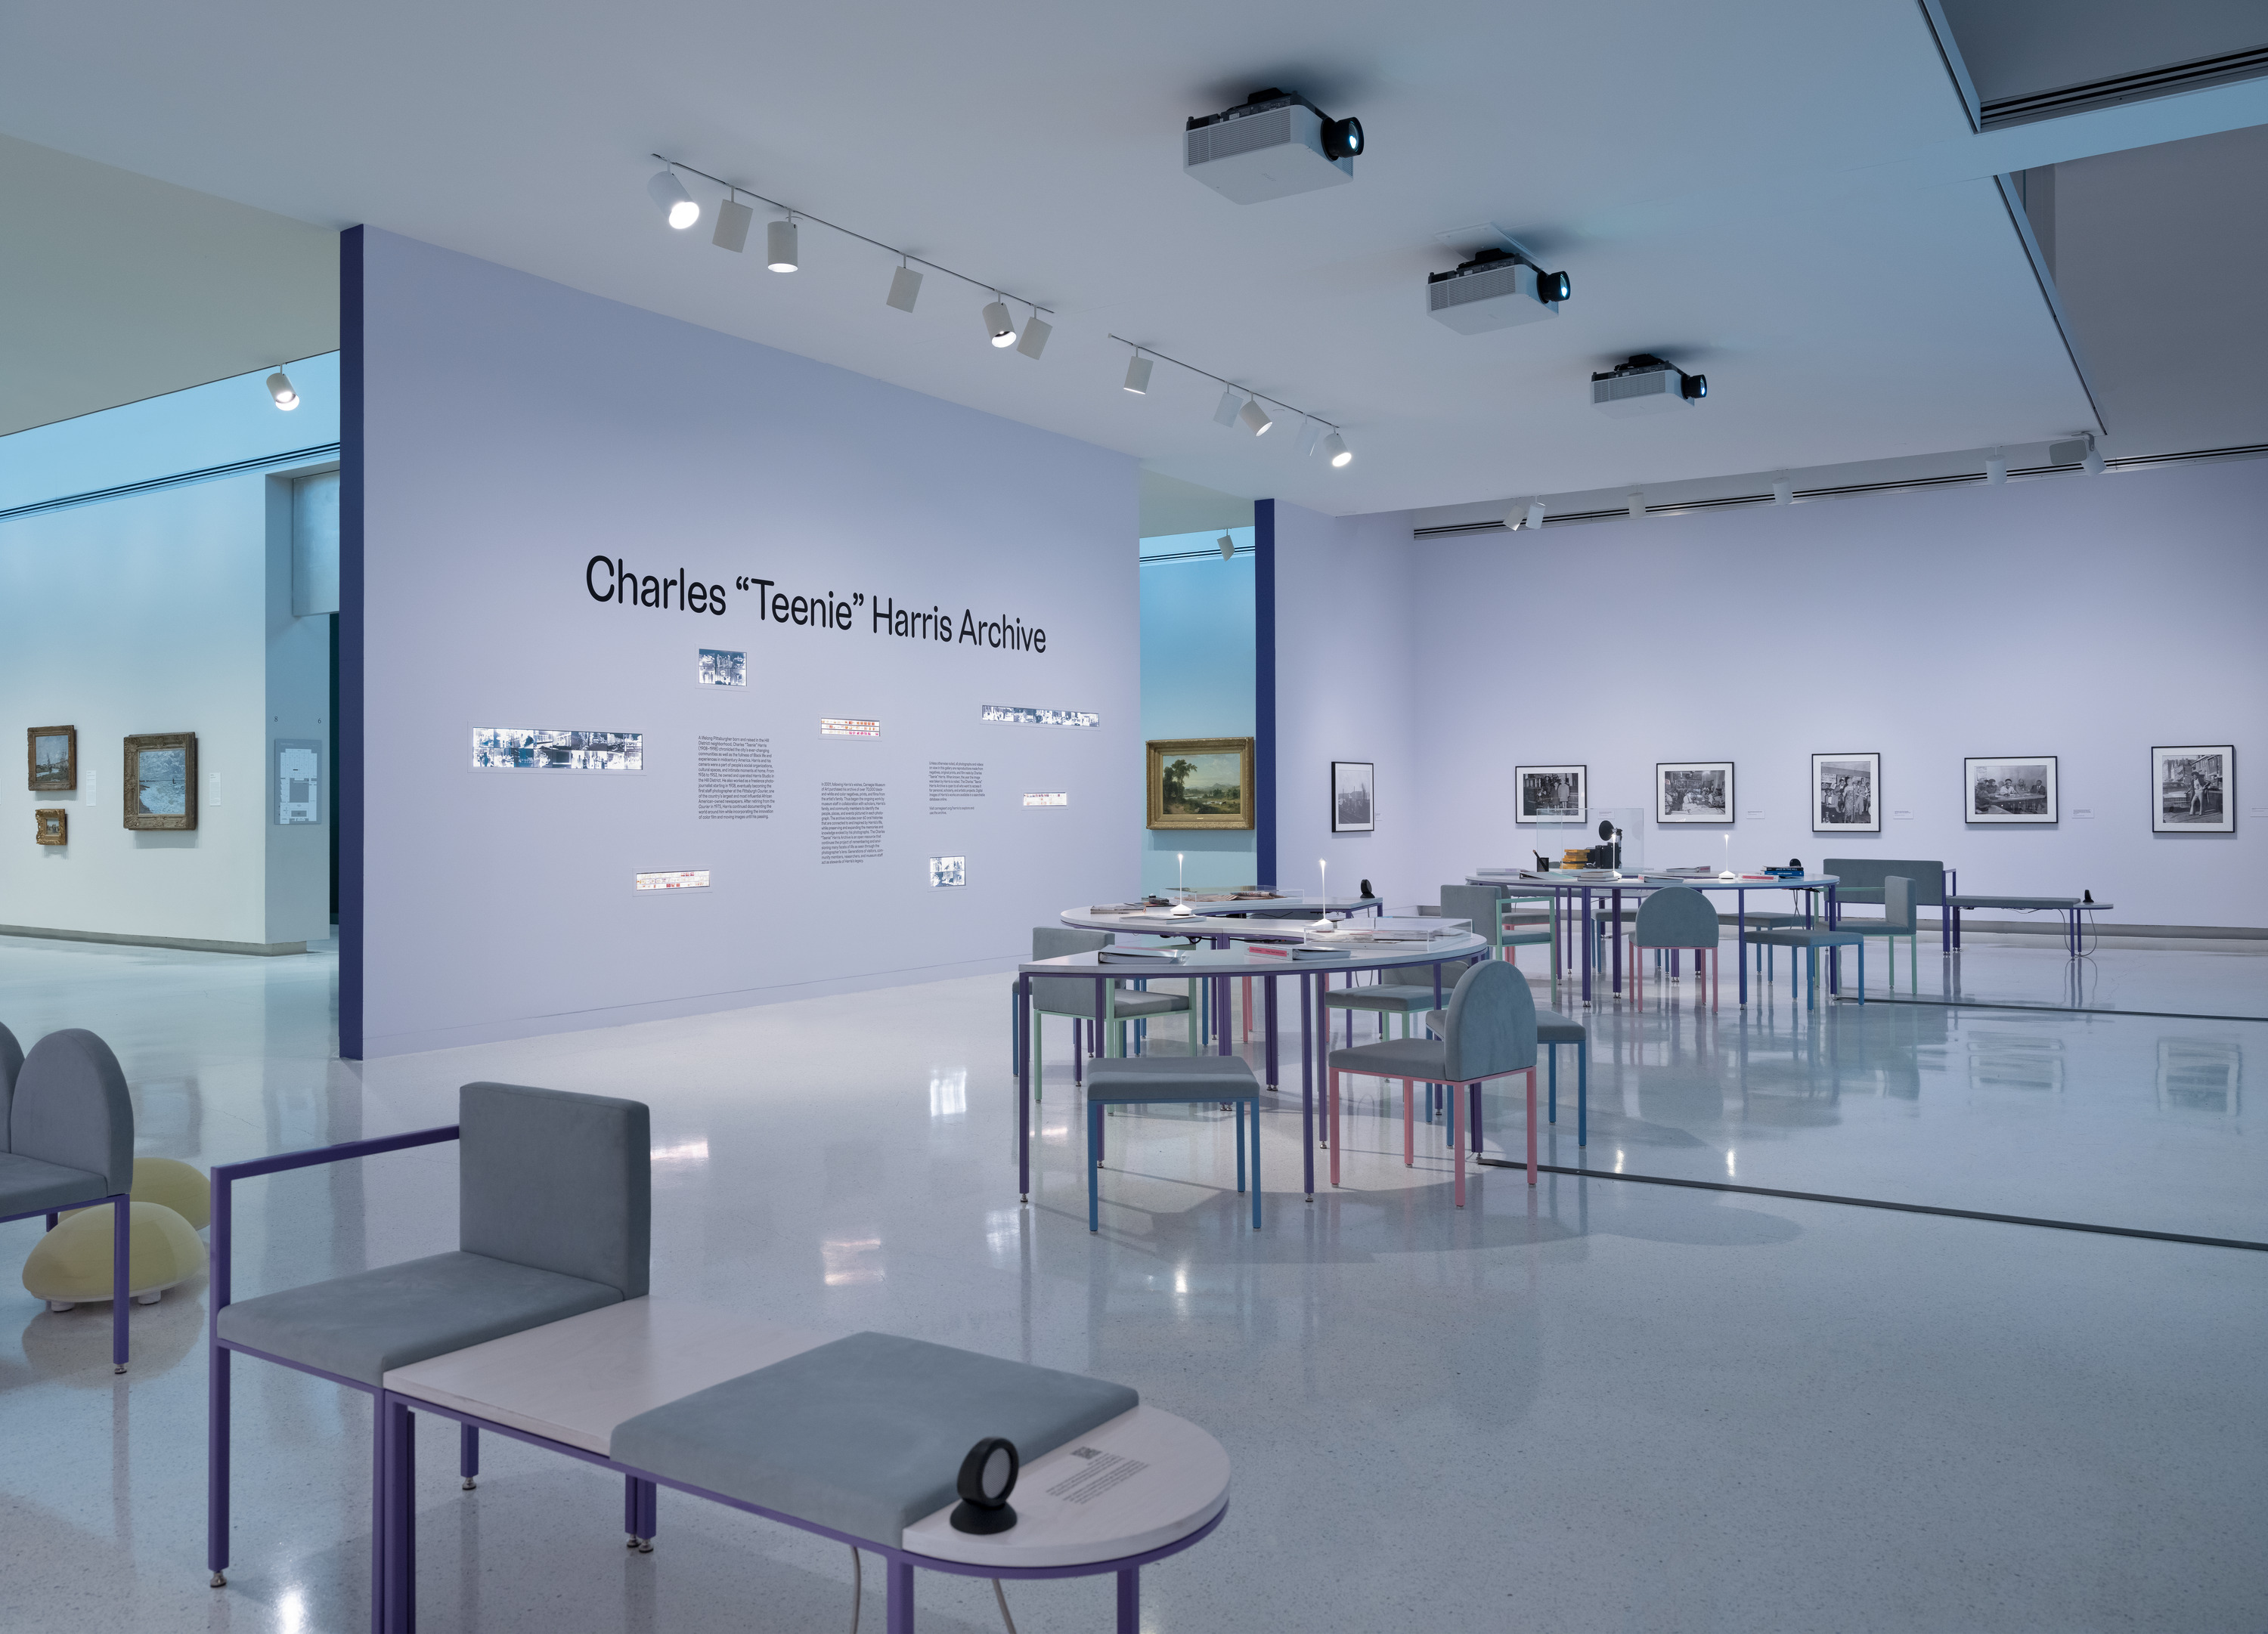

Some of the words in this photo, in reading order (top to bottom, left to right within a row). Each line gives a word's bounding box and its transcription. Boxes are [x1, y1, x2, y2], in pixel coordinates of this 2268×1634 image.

[587, 555, 726, 615] Charles
[736, 576, 863, 630] “Teenie”
[873, 596, 952, 642] Harris
[959, 609, 1046, 653] Archive
